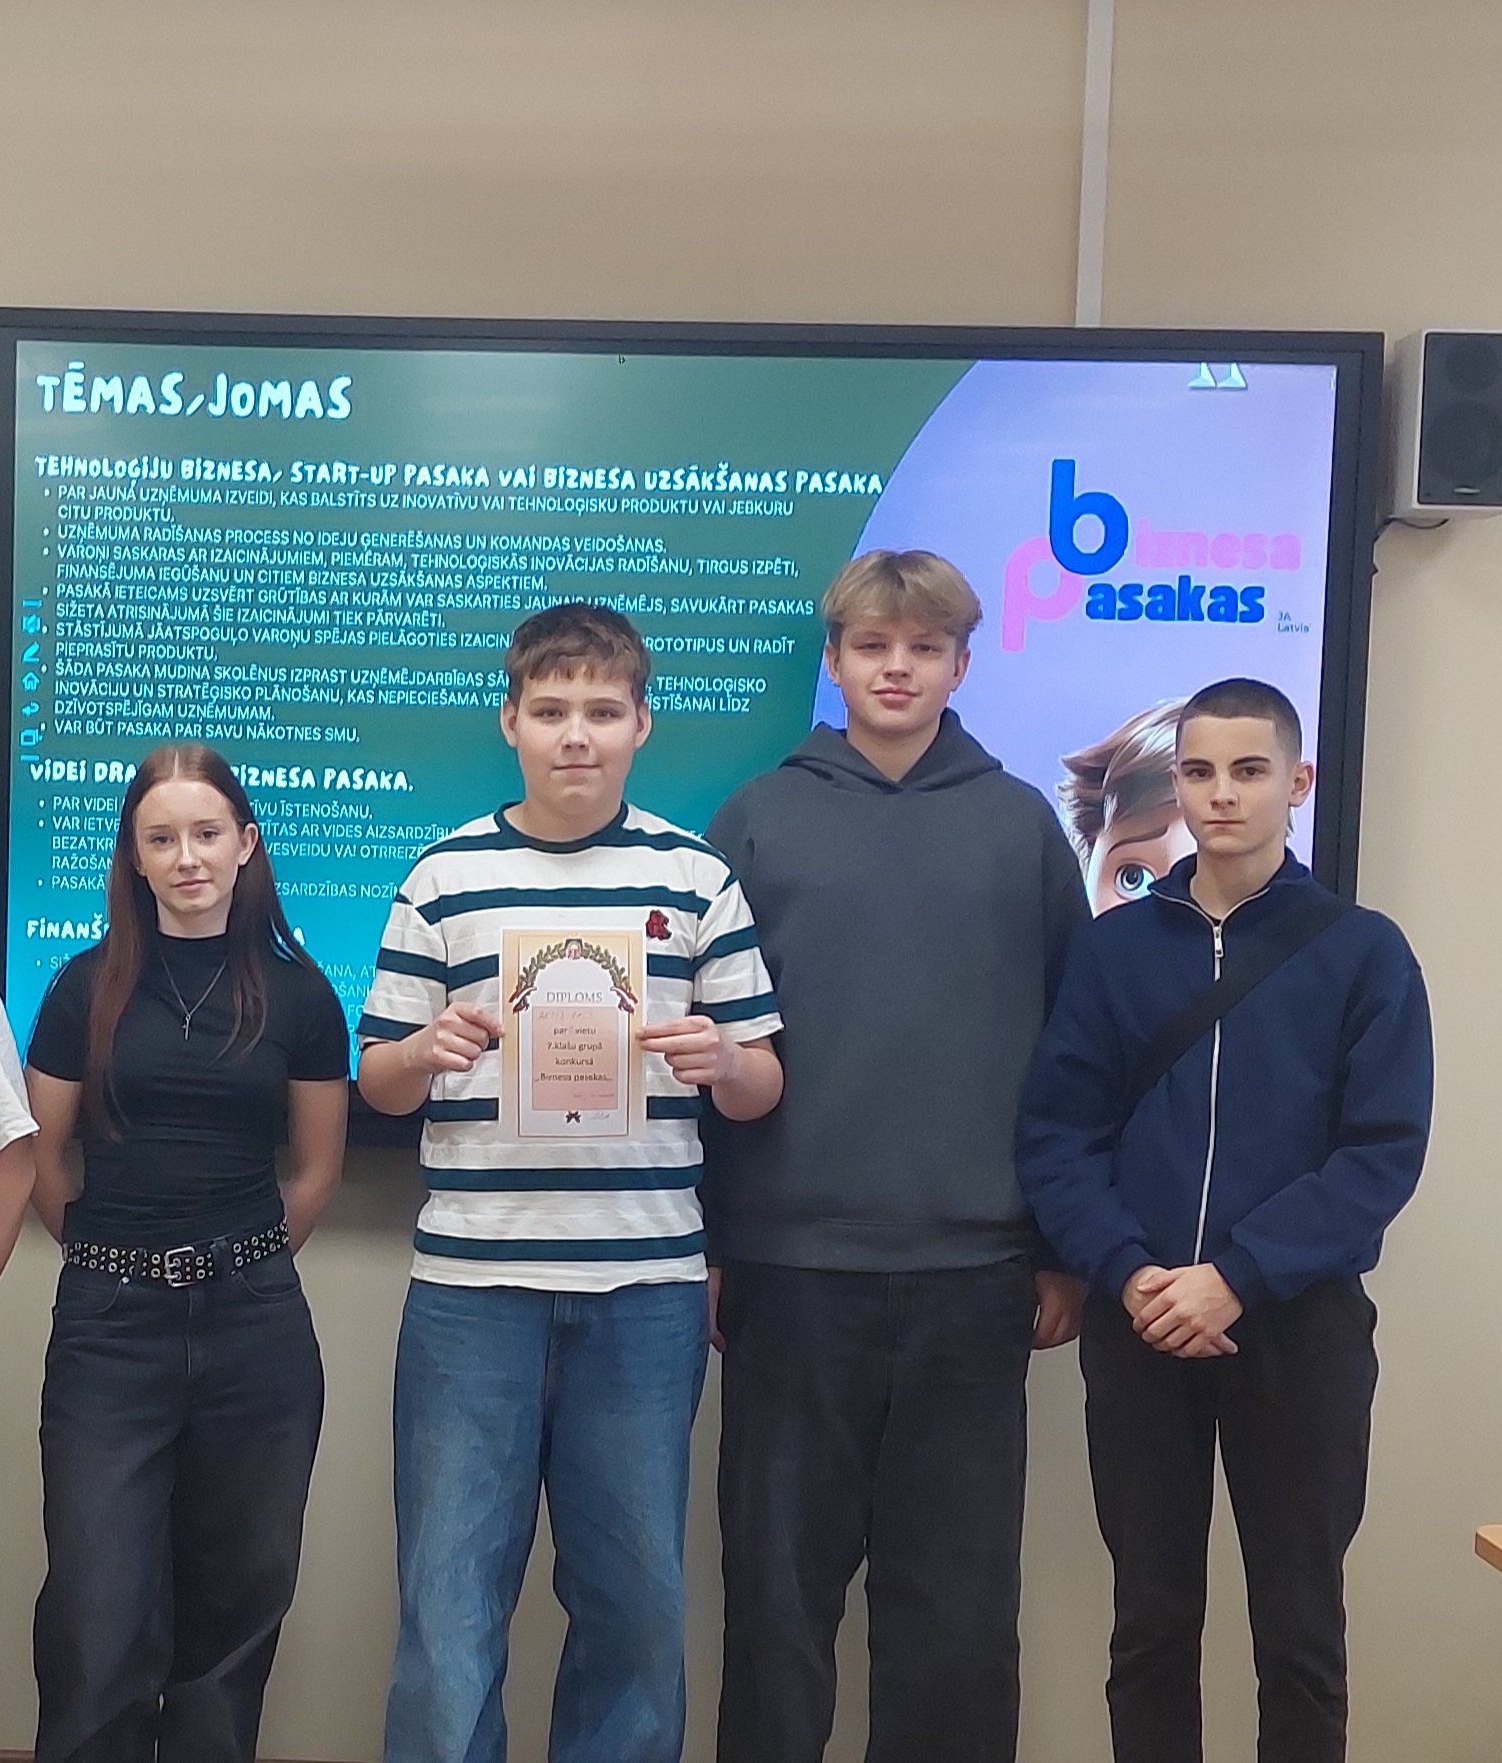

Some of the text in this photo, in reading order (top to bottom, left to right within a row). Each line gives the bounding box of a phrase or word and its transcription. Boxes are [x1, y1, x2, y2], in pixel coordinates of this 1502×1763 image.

[35, 456, 173, 487] TEHNOLOĢIJU
[290, 461, 397, 486] START-UP
[404, 464, 490, 488] PASAKA
[498, 465, 536, 488] VAI
[544, 466, 636, 490] BIZNESA
[645, 462, 788, 493] UZSĀKŠANAS
[795, 471, 882, 494] PASAKA
[58, 485, 85, 500] PAR
[140, 486, 222, 506] UZŅĒMUMA
[226, 488, 277, 508] IZVEIDI,
[280, 490, 307, 506] KAS
[311, 490, 376, 507] BALSTĪTS
[380, 493, 399, 508] UZ
[403, 492, 478, 510] INOVATĪVU
[482, 495, 504, 510] VAI
[509, 497, 617, 516] TEHNOLOĢISKU
[621, 498, 698, 514] PRODUKTU
[703, 500, 725, 515] VAI
[58, 505, 90, 519] CITU
[58, 523, 140, 543] UZŅĒMUMA
[144, 525, 221, 542] RADĪŠANAS
[226, 529, 289, 545] PROCESS
[293, 531, 314, 546] NO
[318, 531, 357, 547] IDEJU
[466, 535, 487, 549] UN
[490, 535, 570, 550] KOMANDAS
[58, 544, 798, 578] VAROŅI SASKARAS AR IZAICINĀJUMIEM, PIEMĒRAM, TEHNOLOĢISKĀS INOVĀCIJAS RADĪŠANU, TIRGUS IZPĒTI,
[57, 563, 155, 580] FINANSĒJUMA
[159, 564, 230, 582] IEGŪŠANU
[234, 568, 253, 583] UN
[258, 569, 304, 584] CITIEM
[308, 570, 366, 586] BIZNESA
[371, 570, 462, 589] UZSĀKŠANAS
[56, 582, 111, 599] PASAKĀ
[115, 585, 187, 600] IETEICAMS
[192, 585, 254, 602] UZSVĒRT
[259, 587, 326, 604] GRŪTĪBAS
[331, 591, 348, 605] AR
[353, 590, 401, 606] KURĀM
[406, 592, 433, 607] VAR
[437, 594, 520, 610] SASKARTIES
[671, 596, 746, 614] SAVUKĀRT
[749, 599, 814, 615] PASAKAS
[56, 600, 104, 619] SIŽETA
[107, 603, 209, 622] ATRISINĀJUMĀ
[213, 605, 234, 622] ŠIE
[238, 608, 330, 625] IZAICINĀJUMI
[334, 611, 363, 626] TIEK
[56, 620, 795, 654] STĀSTĪJUMĀ JĀATSPOGUĻO VAROŅU SPĒJAS PIELĀGOTIES IZAICIN ROTOTIPUS UN RADĪT
[56, 641, 135, 658] PIEPRASĪTU
[55, 658, 93, 676] ŠĀDA
[98, 662, 151, 678] PASAKA
[154, 663, 209, 680] MUDINA
[214, 664, 287, 683] SKOLĒNUS
[290, 667, 347, 684] IZPRAST
[351, 667, 483, 688] UZŅĒMĒJDARBĪBAS
[656, 676, 766, 697] TEHNOLOĢISKO
[54, 698, 173, 719] DZĪVOTSPĒJĪGAM
[55, 679, 129, 696] INOVĀCIJU
[134, 681, 153, 697] UN
[157, 682, 251, 703] STRATĒĢISKO
[256, 684, 343, 705] PLĀNOŠANU,
[348, 689, 374, 704] KAS
[378, 688, 479, 706] NEPIECIEŠAMA
[645, 695, 715, 712] ĪSTĪŠANAI
[720, 696, 750, 713] LĪDZ
[54, 720, 82, 734] VAR
[86, 718, 113, 735] BŪT
[117, 721, 171, 737] PASAKA
[175, 723, 201, 738] PAR
[206, 723, 242, 739] SAVU
[247, 724, 321, 741] NĀKOTNES
[30, 758, 86, 784] VIDEI
[53, 797, 80, 811] PAR
[84, 797, 118, 812] VIDEI
[52, 816, 80, 831] VAR
[84, 817, 120, 831] IETVE
[259, 820, 297, 836] TĪTAS
[301, 822, 319, 837] AR
[322, 824, 362, 839] VIDES
[52, 853, 113, 870] RAŽOŠAN
[266, 842, 330, 857] VESVEIDU
[334, 844, 356, 858] VAI
[274, 881, 357, 898] ZSARDZĪBAS
[27, 913, 109, 940] FINANŠ
[547, 992, 602, 1002] DIPLOMS
[554, 1027, 567, 1035] par
